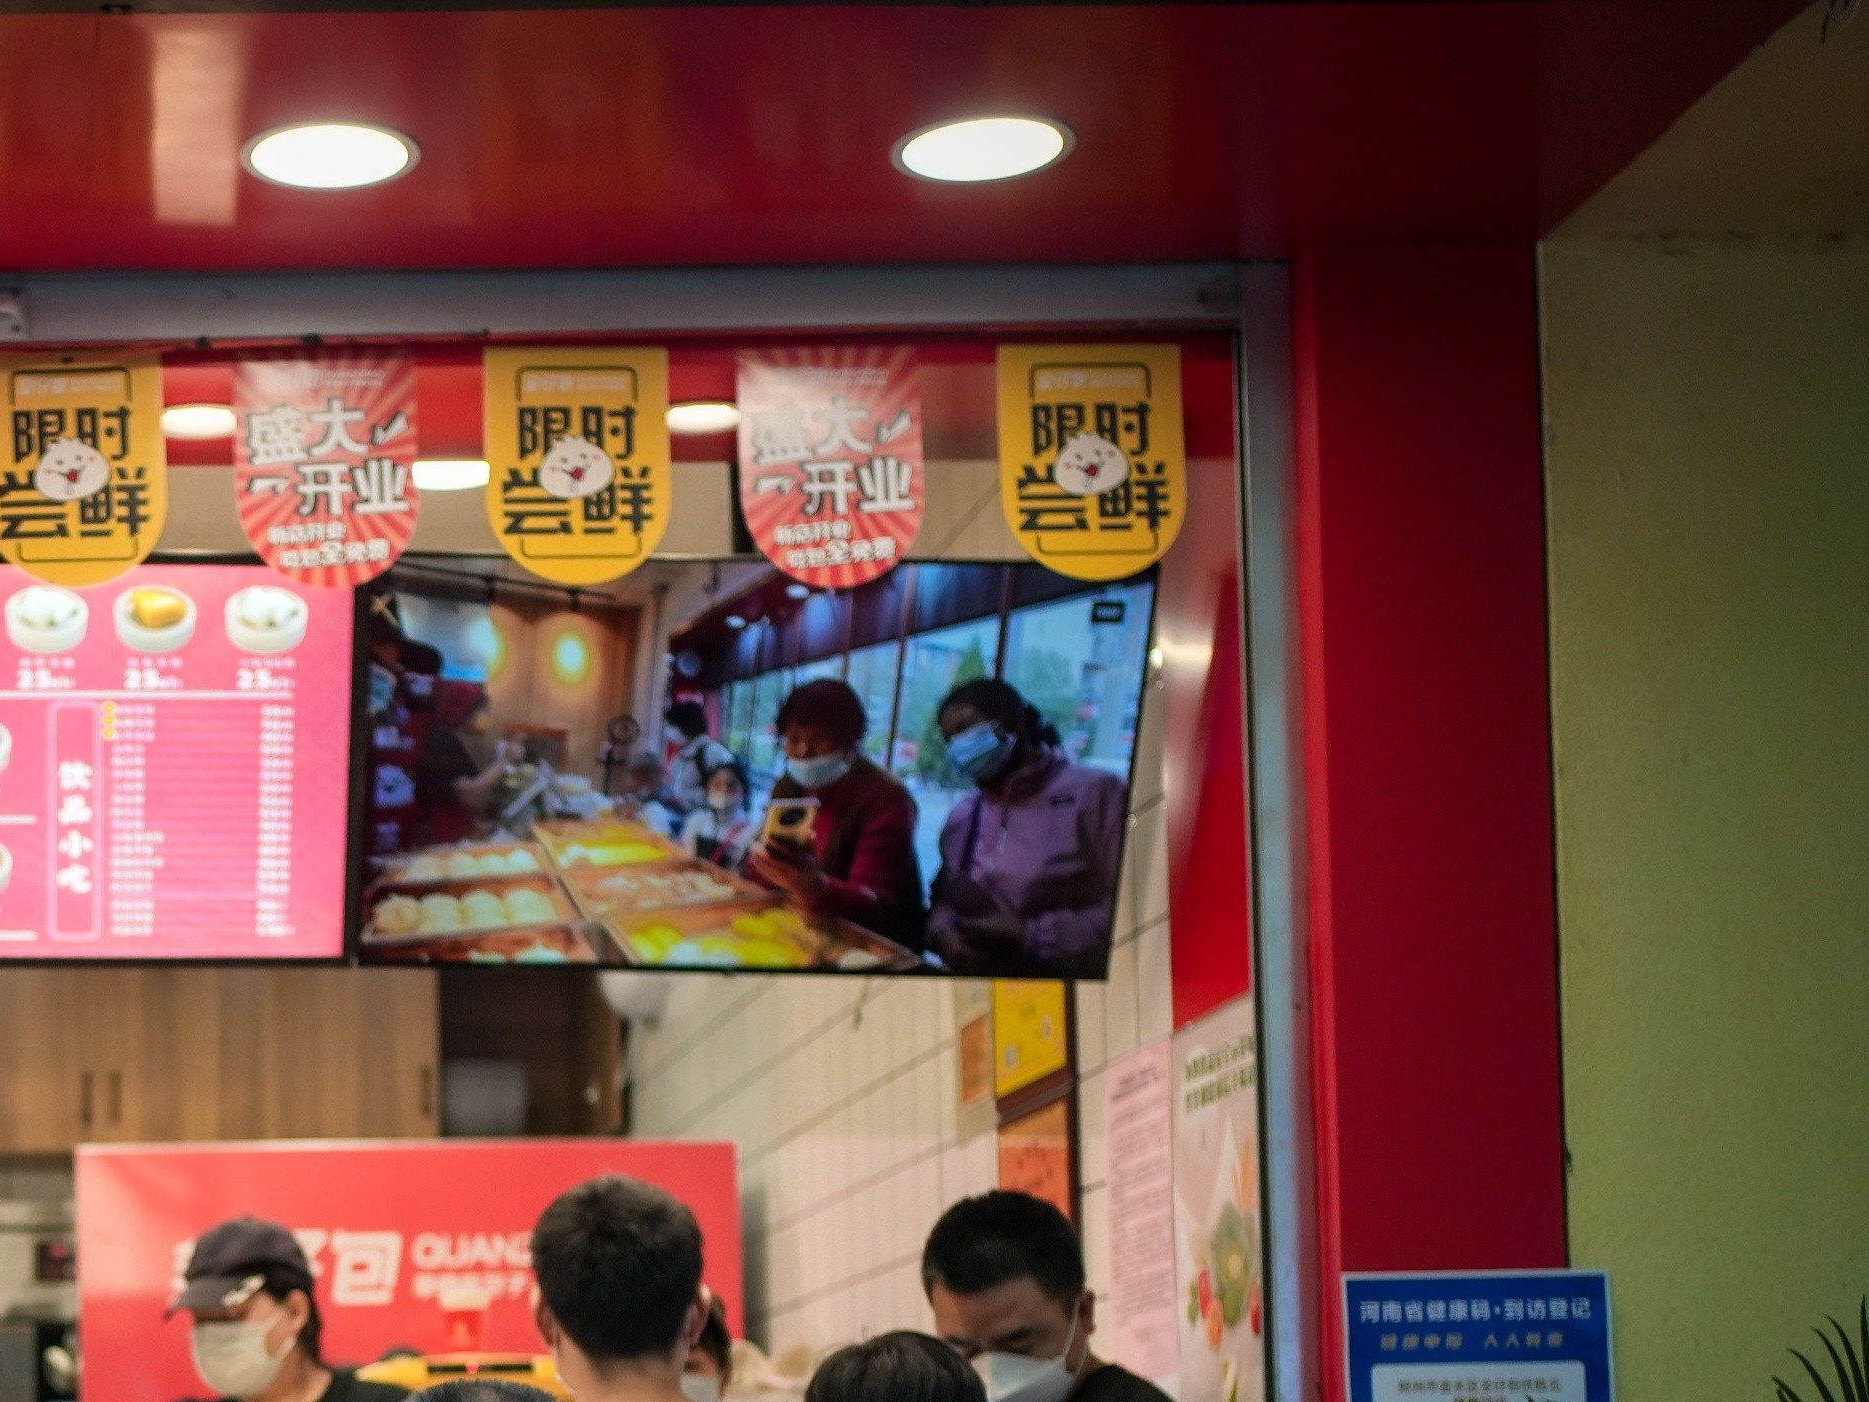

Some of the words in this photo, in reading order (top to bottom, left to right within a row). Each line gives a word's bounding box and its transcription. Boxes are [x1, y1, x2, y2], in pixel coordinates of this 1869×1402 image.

[12, 407, 130, 463] 限时
[249, 396, 369, 465] 盛大
[518, 406, 637, 460] 限时
[751, 398, 872, 466] 盛大
[1033, 401, 1151, 457] 限时
[0, 467, 149, 540] 尝鲜
[297, 458, 411, 517] 开业
[504, 466, 654, 535] 尝鲜
[801, 456, 914, 517] 开业
[1020, 461, 1170, 532] 尝鲜
